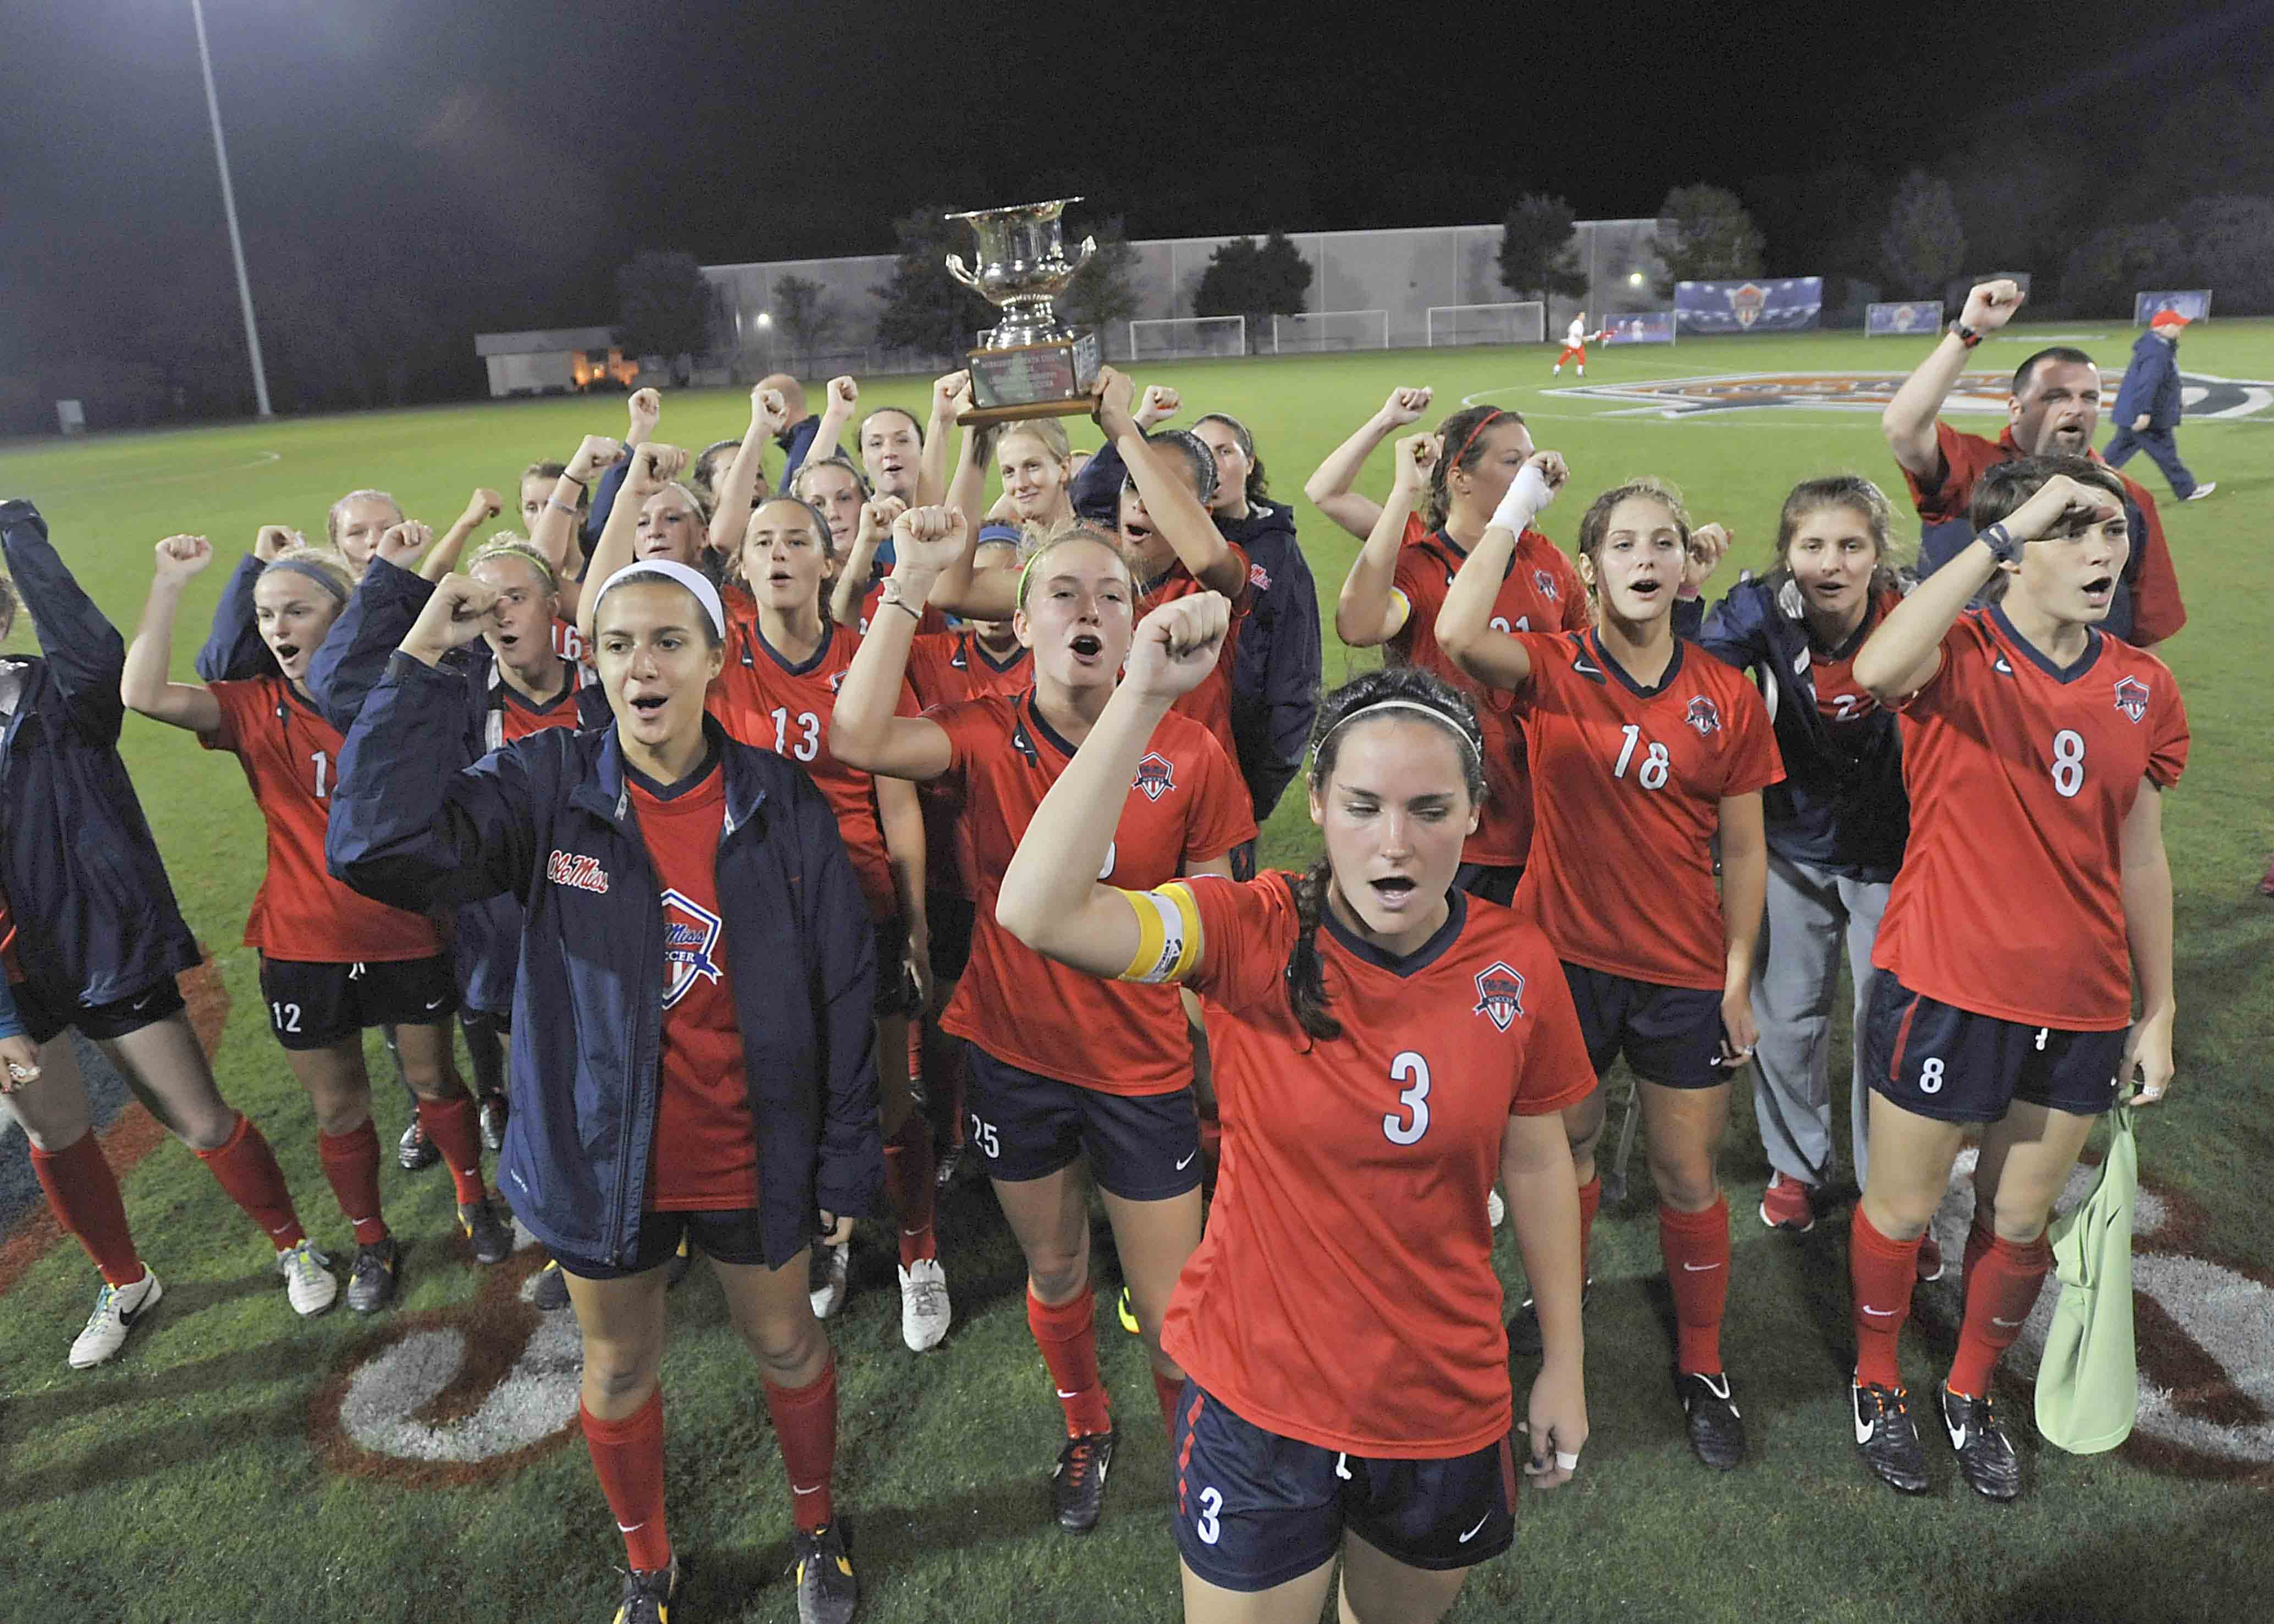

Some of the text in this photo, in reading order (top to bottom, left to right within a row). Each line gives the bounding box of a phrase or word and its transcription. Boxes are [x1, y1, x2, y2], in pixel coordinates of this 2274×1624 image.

[771, 706, 820, 762] 13
[1614, 724, 1670, 789] 18
[311, 750, 329, 798] 1
[2051, 729, 2085, 798] 8
[273, 1001, 302, 1032] 12
[1382, 1050, 1431, 1146] 3
[1919, 1058, 1945, 1094] 8
[972, 1113, 1000, 1159] 25
[1197, 1486, 1223, 1545] 3
